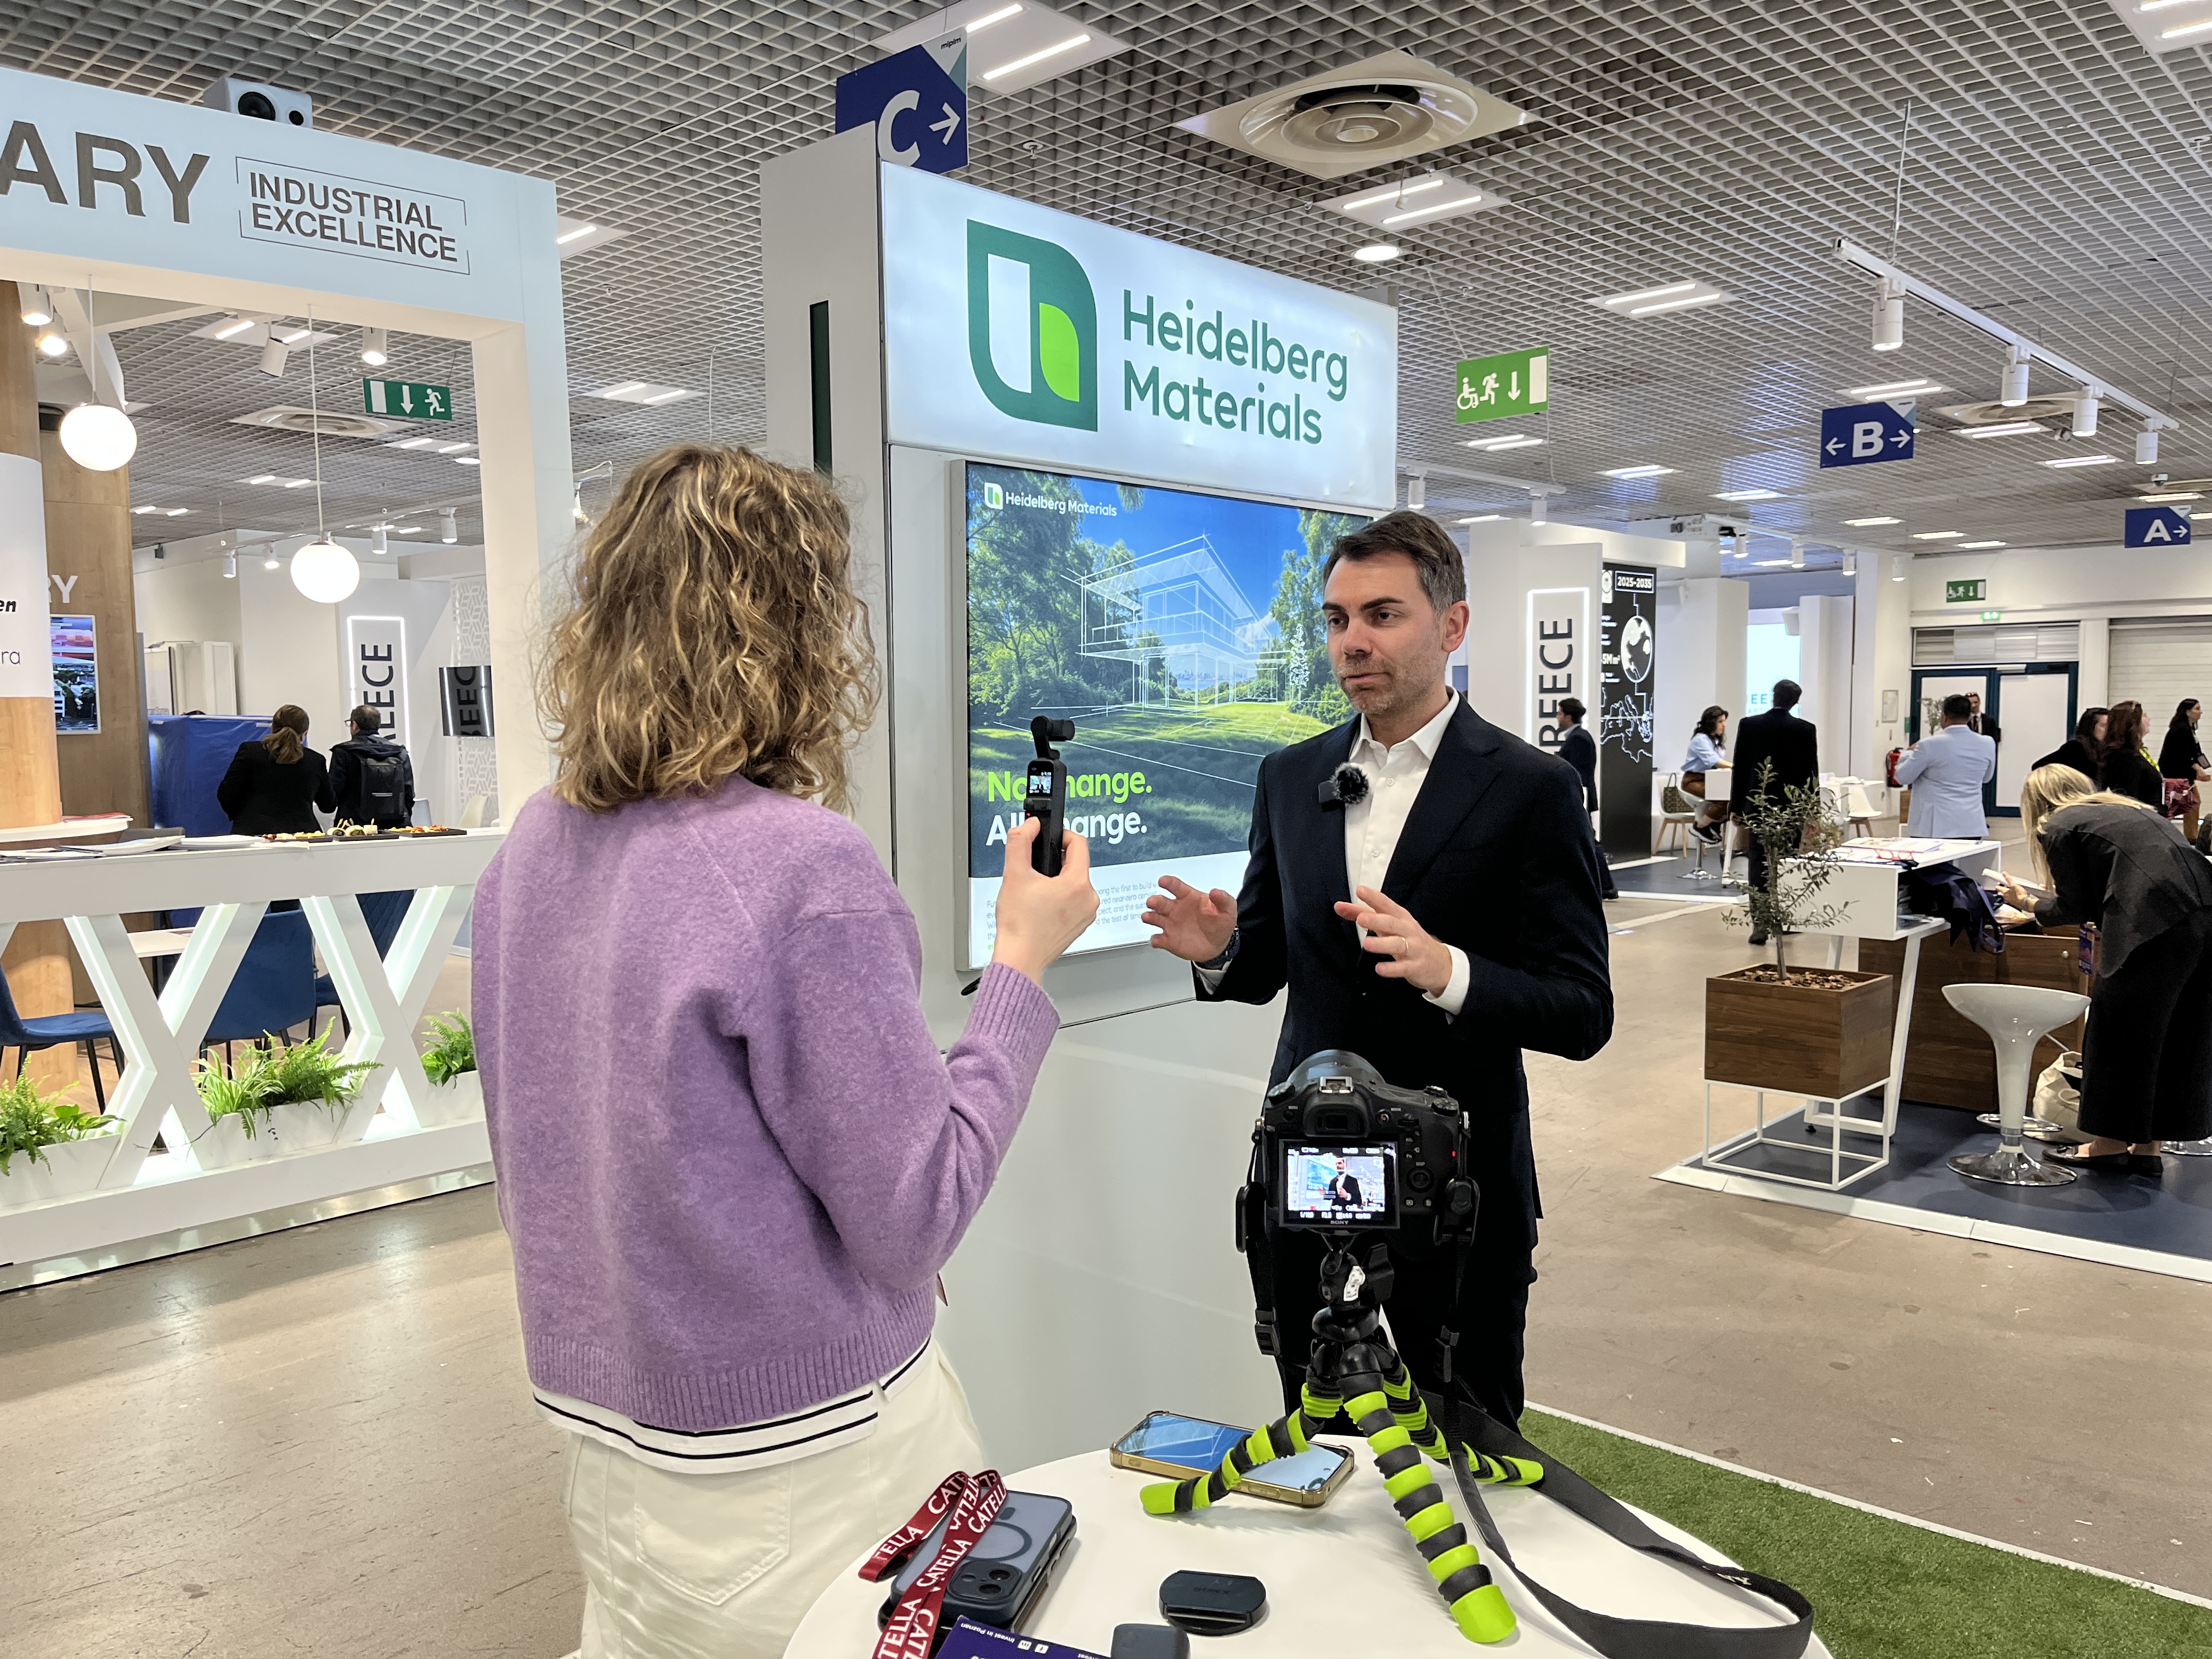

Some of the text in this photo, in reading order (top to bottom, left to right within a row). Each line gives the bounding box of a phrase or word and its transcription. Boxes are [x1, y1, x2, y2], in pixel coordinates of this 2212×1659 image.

[940, 36, 962, 50] mipim
[877, 89, 921, 167] C
[0, 120, 211, 224] ARY
[250, 172, 443, 231] INDUSTRIAL
[252, 202, 458, 262] EXCELLENCE
[1123, 289, 1348, 402] Heidelberg
[1124, 359, 1323, 445] Materials
[1852, 421, 1884, 458] B
[1005, 491, 1118, 517] Heidelberg Materials
[2143, 518, 2172, 543] A
[1617, 576, 1652, 589] 2025-2035
[0, 651, 21, 665] ra
[1539, 618, 1573, 755] REECE
[1112, 894, 1137, 903] near-zero
[1123, 913, 1130, 921] of
[916, 1539, 973, 1587] CATELLA
[877, 1598, 922, 1659] TELLA
